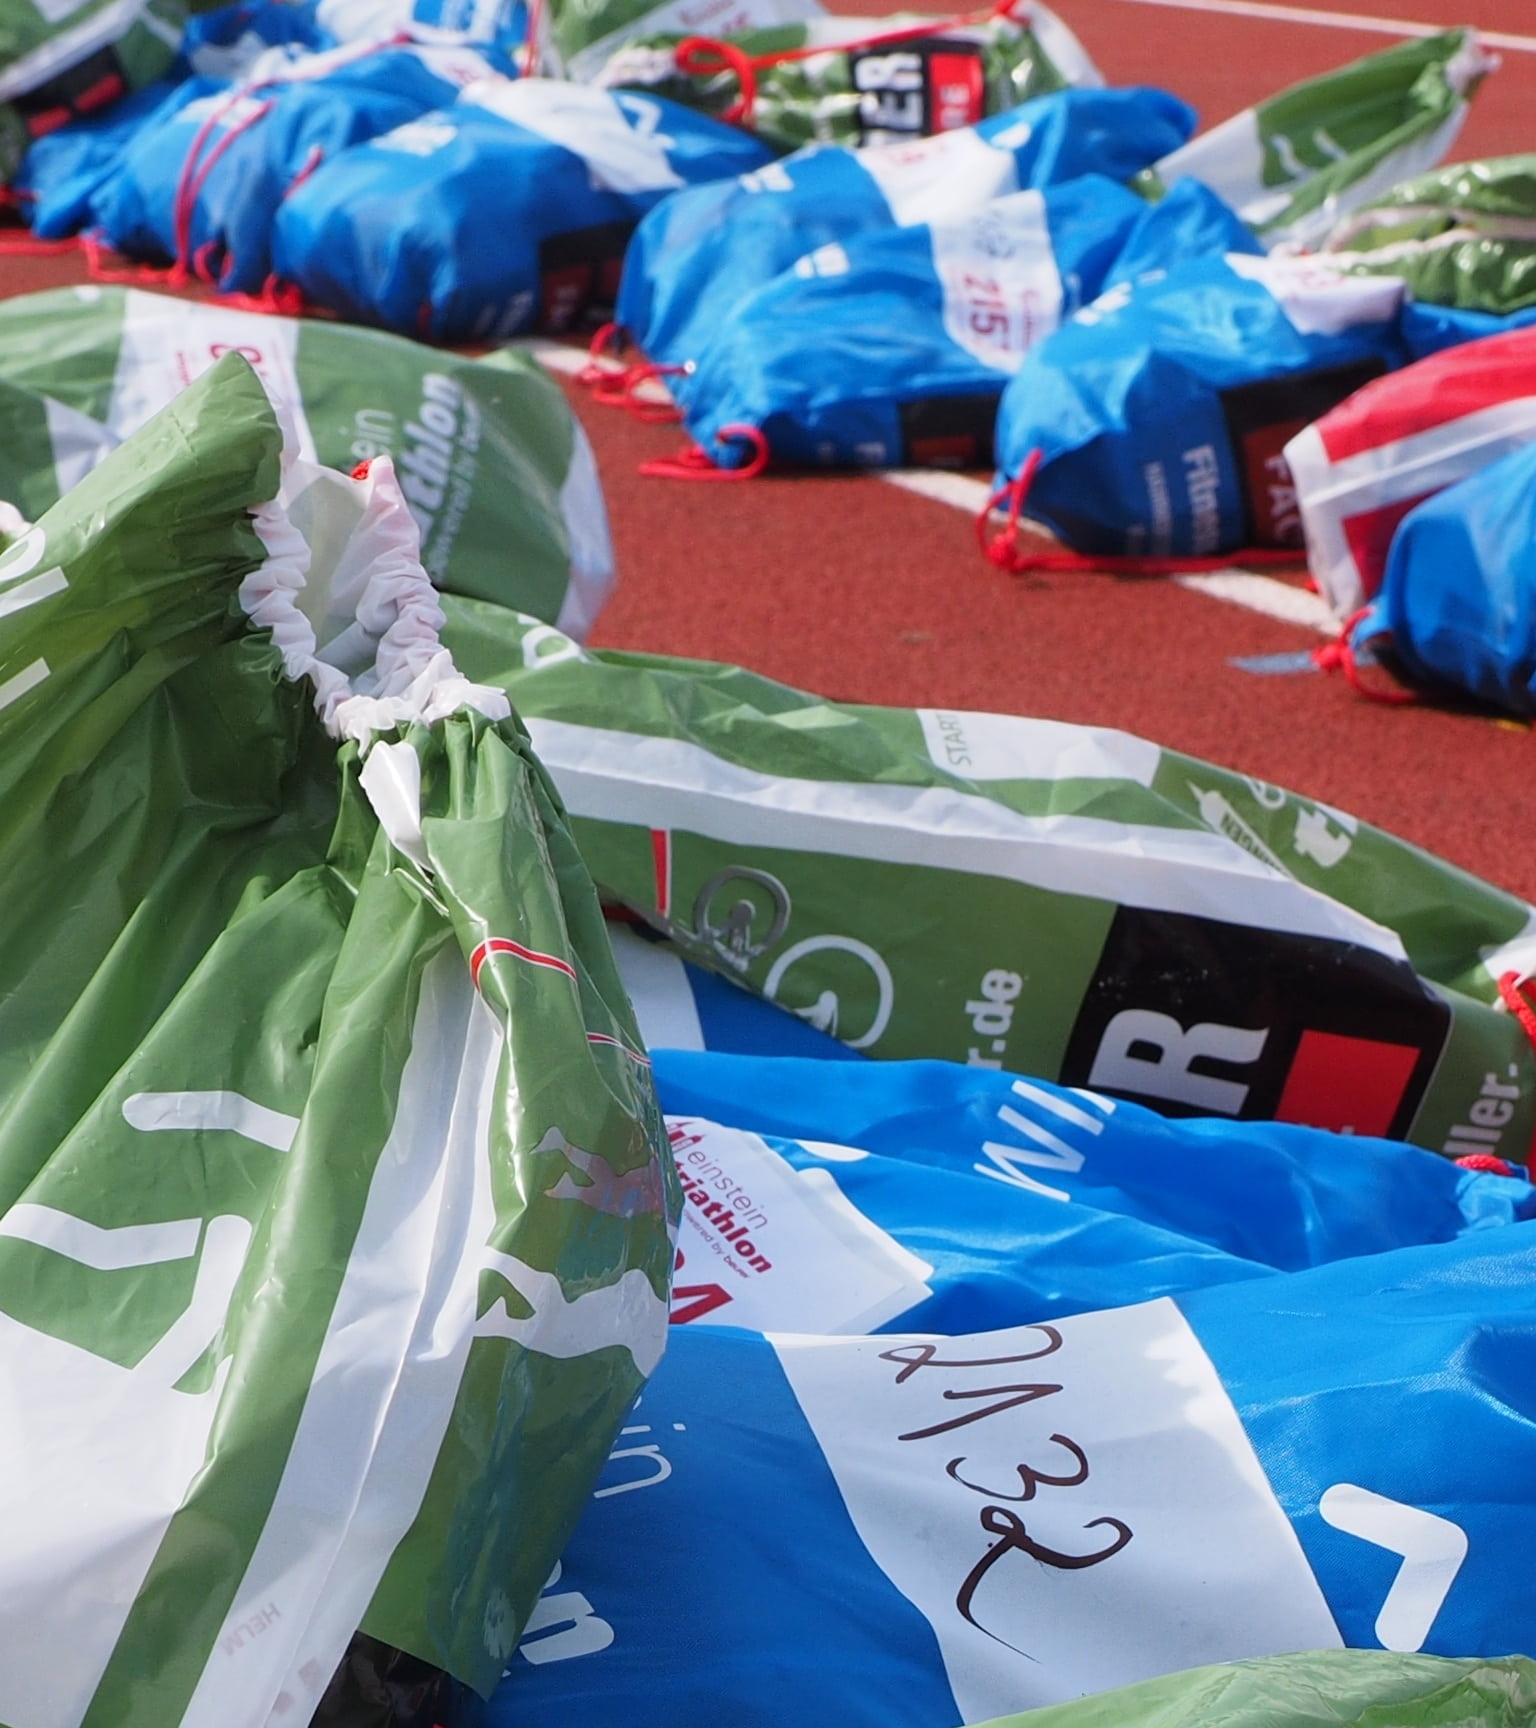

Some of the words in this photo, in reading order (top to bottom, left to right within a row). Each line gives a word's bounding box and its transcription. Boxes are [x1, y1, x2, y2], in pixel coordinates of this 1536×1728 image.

[673, 1159, 773, 1275] riathlon
[686, 1150, 770, 1231] einstein
[878, 1325, 1134, 1664] 2132
